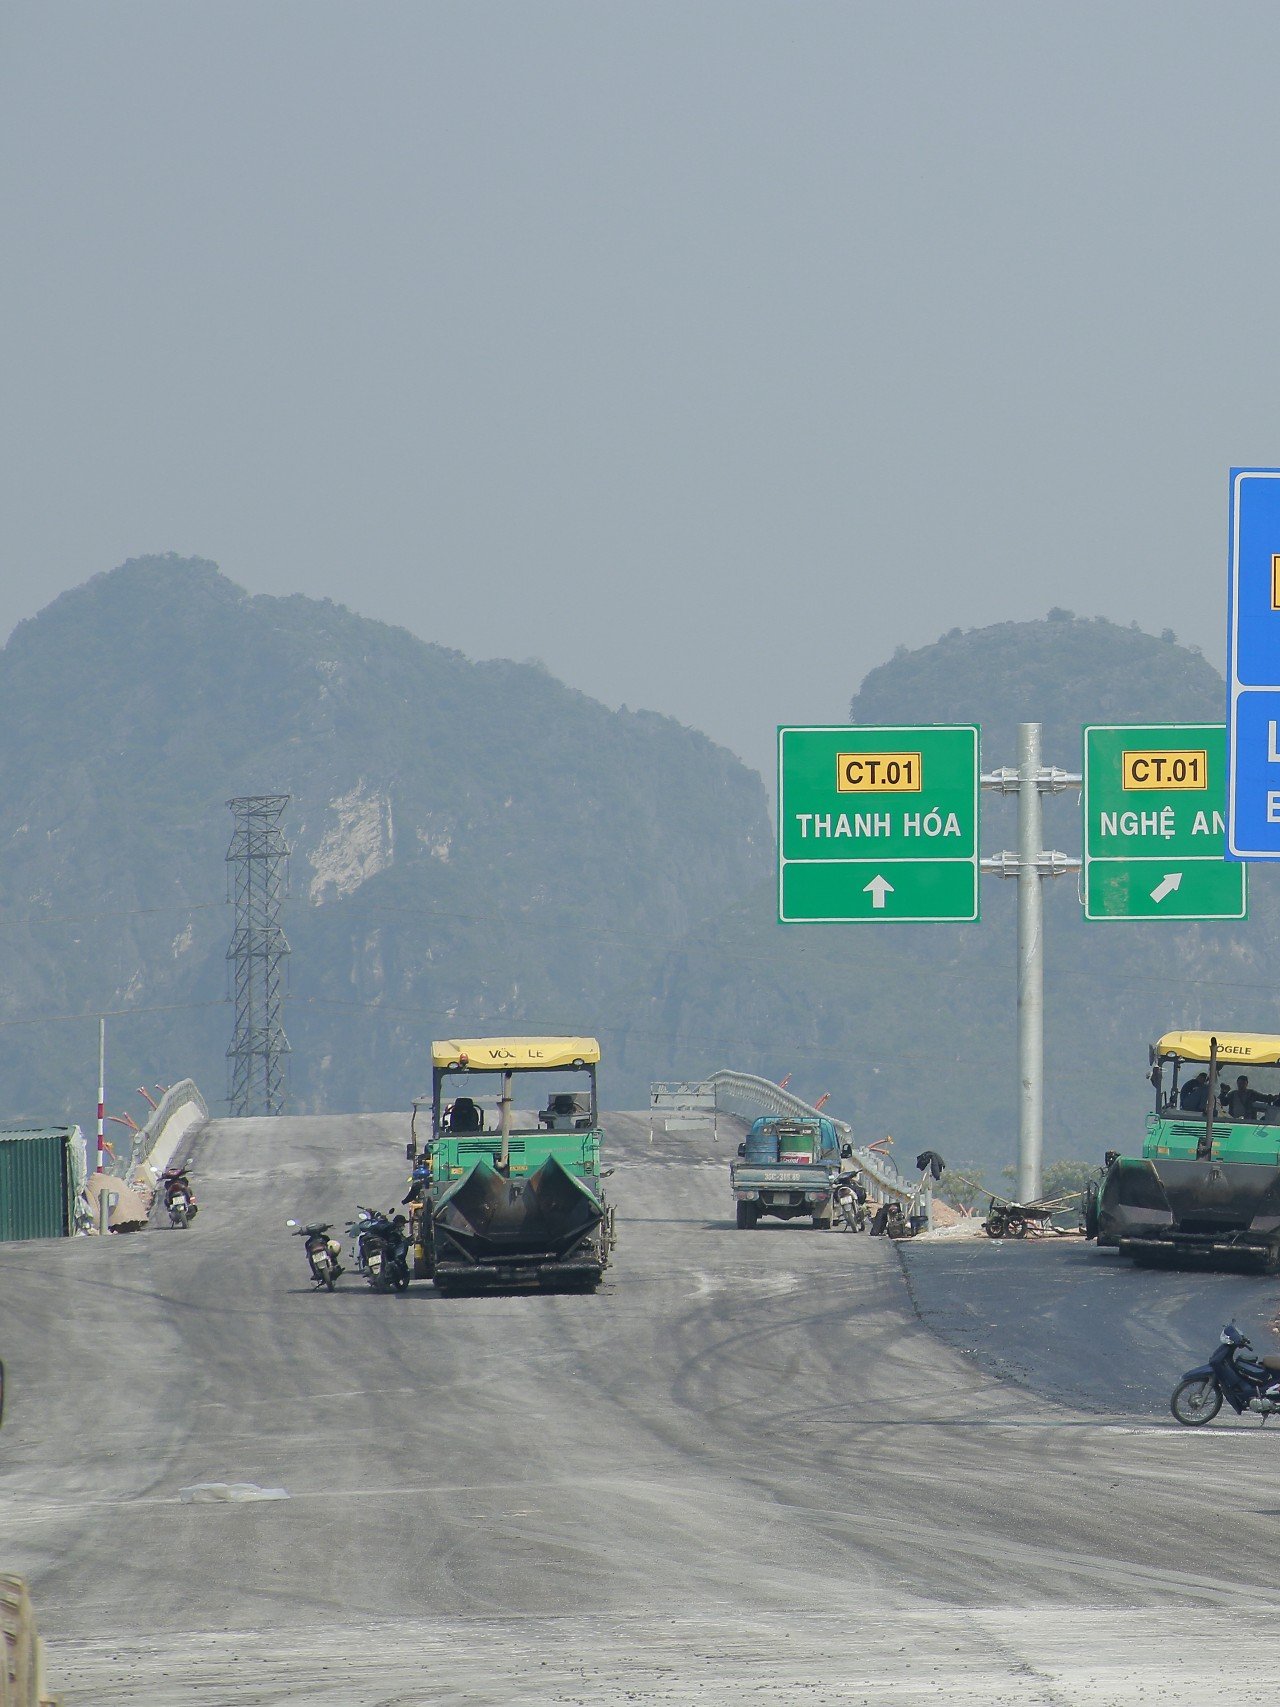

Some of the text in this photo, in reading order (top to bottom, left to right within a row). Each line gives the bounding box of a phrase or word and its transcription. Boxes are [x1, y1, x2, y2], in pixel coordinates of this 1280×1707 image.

[844, 760, 914, 785] CT.01
[1130, 758, 1201, 783] CT.01
[795, 806, 962, 838] THANH HÓA
[1099, 805, 1226, 840] NGHỆ AN
[1216, 1045, 1251, 1055] ÖGELE
